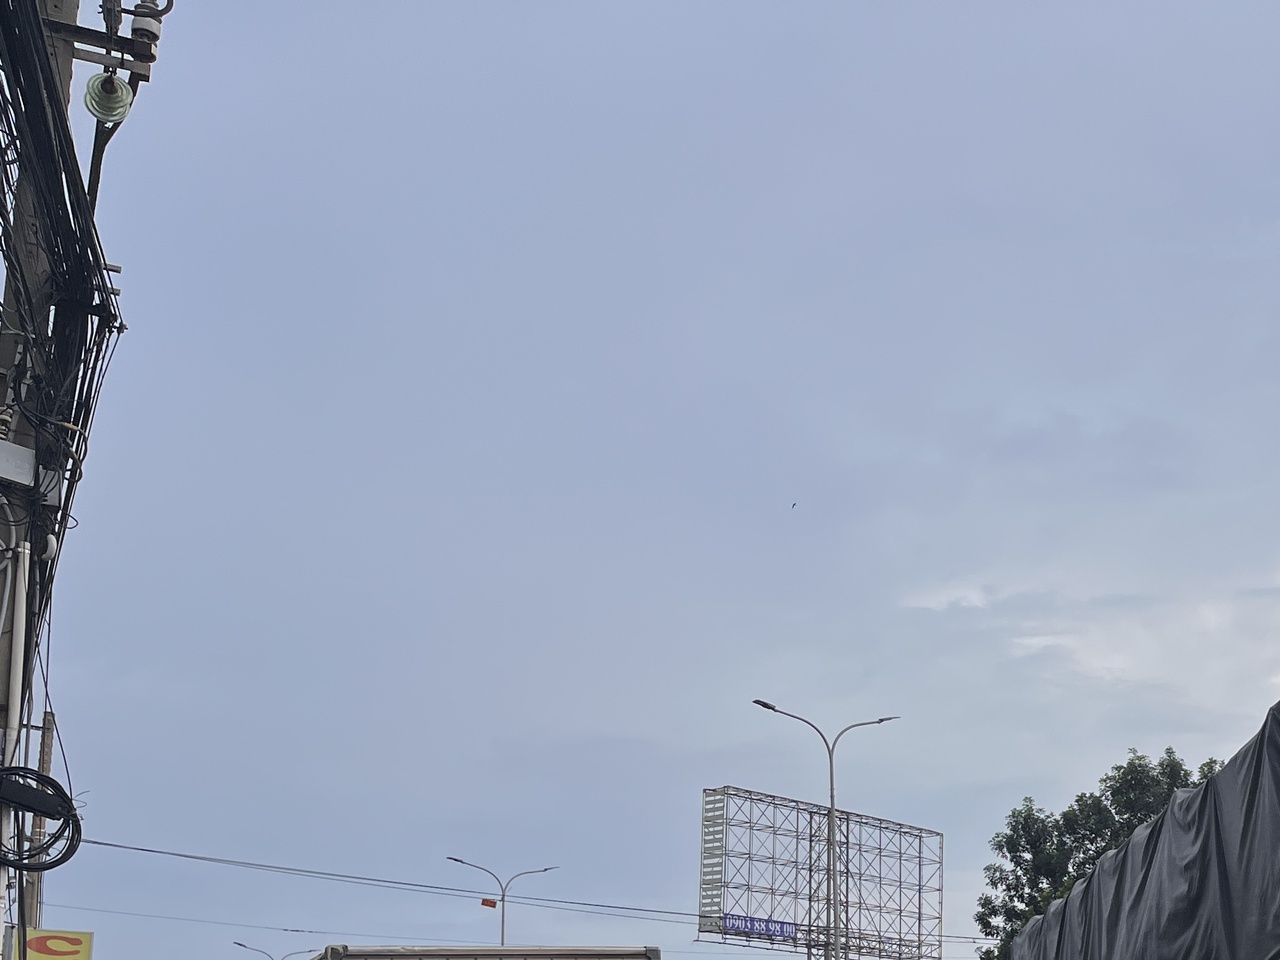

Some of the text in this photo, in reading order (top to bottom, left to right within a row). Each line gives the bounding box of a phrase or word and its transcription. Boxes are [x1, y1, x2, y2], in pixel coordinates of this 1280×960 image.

[726, 914, 796, 937] 0903 88 98 00
